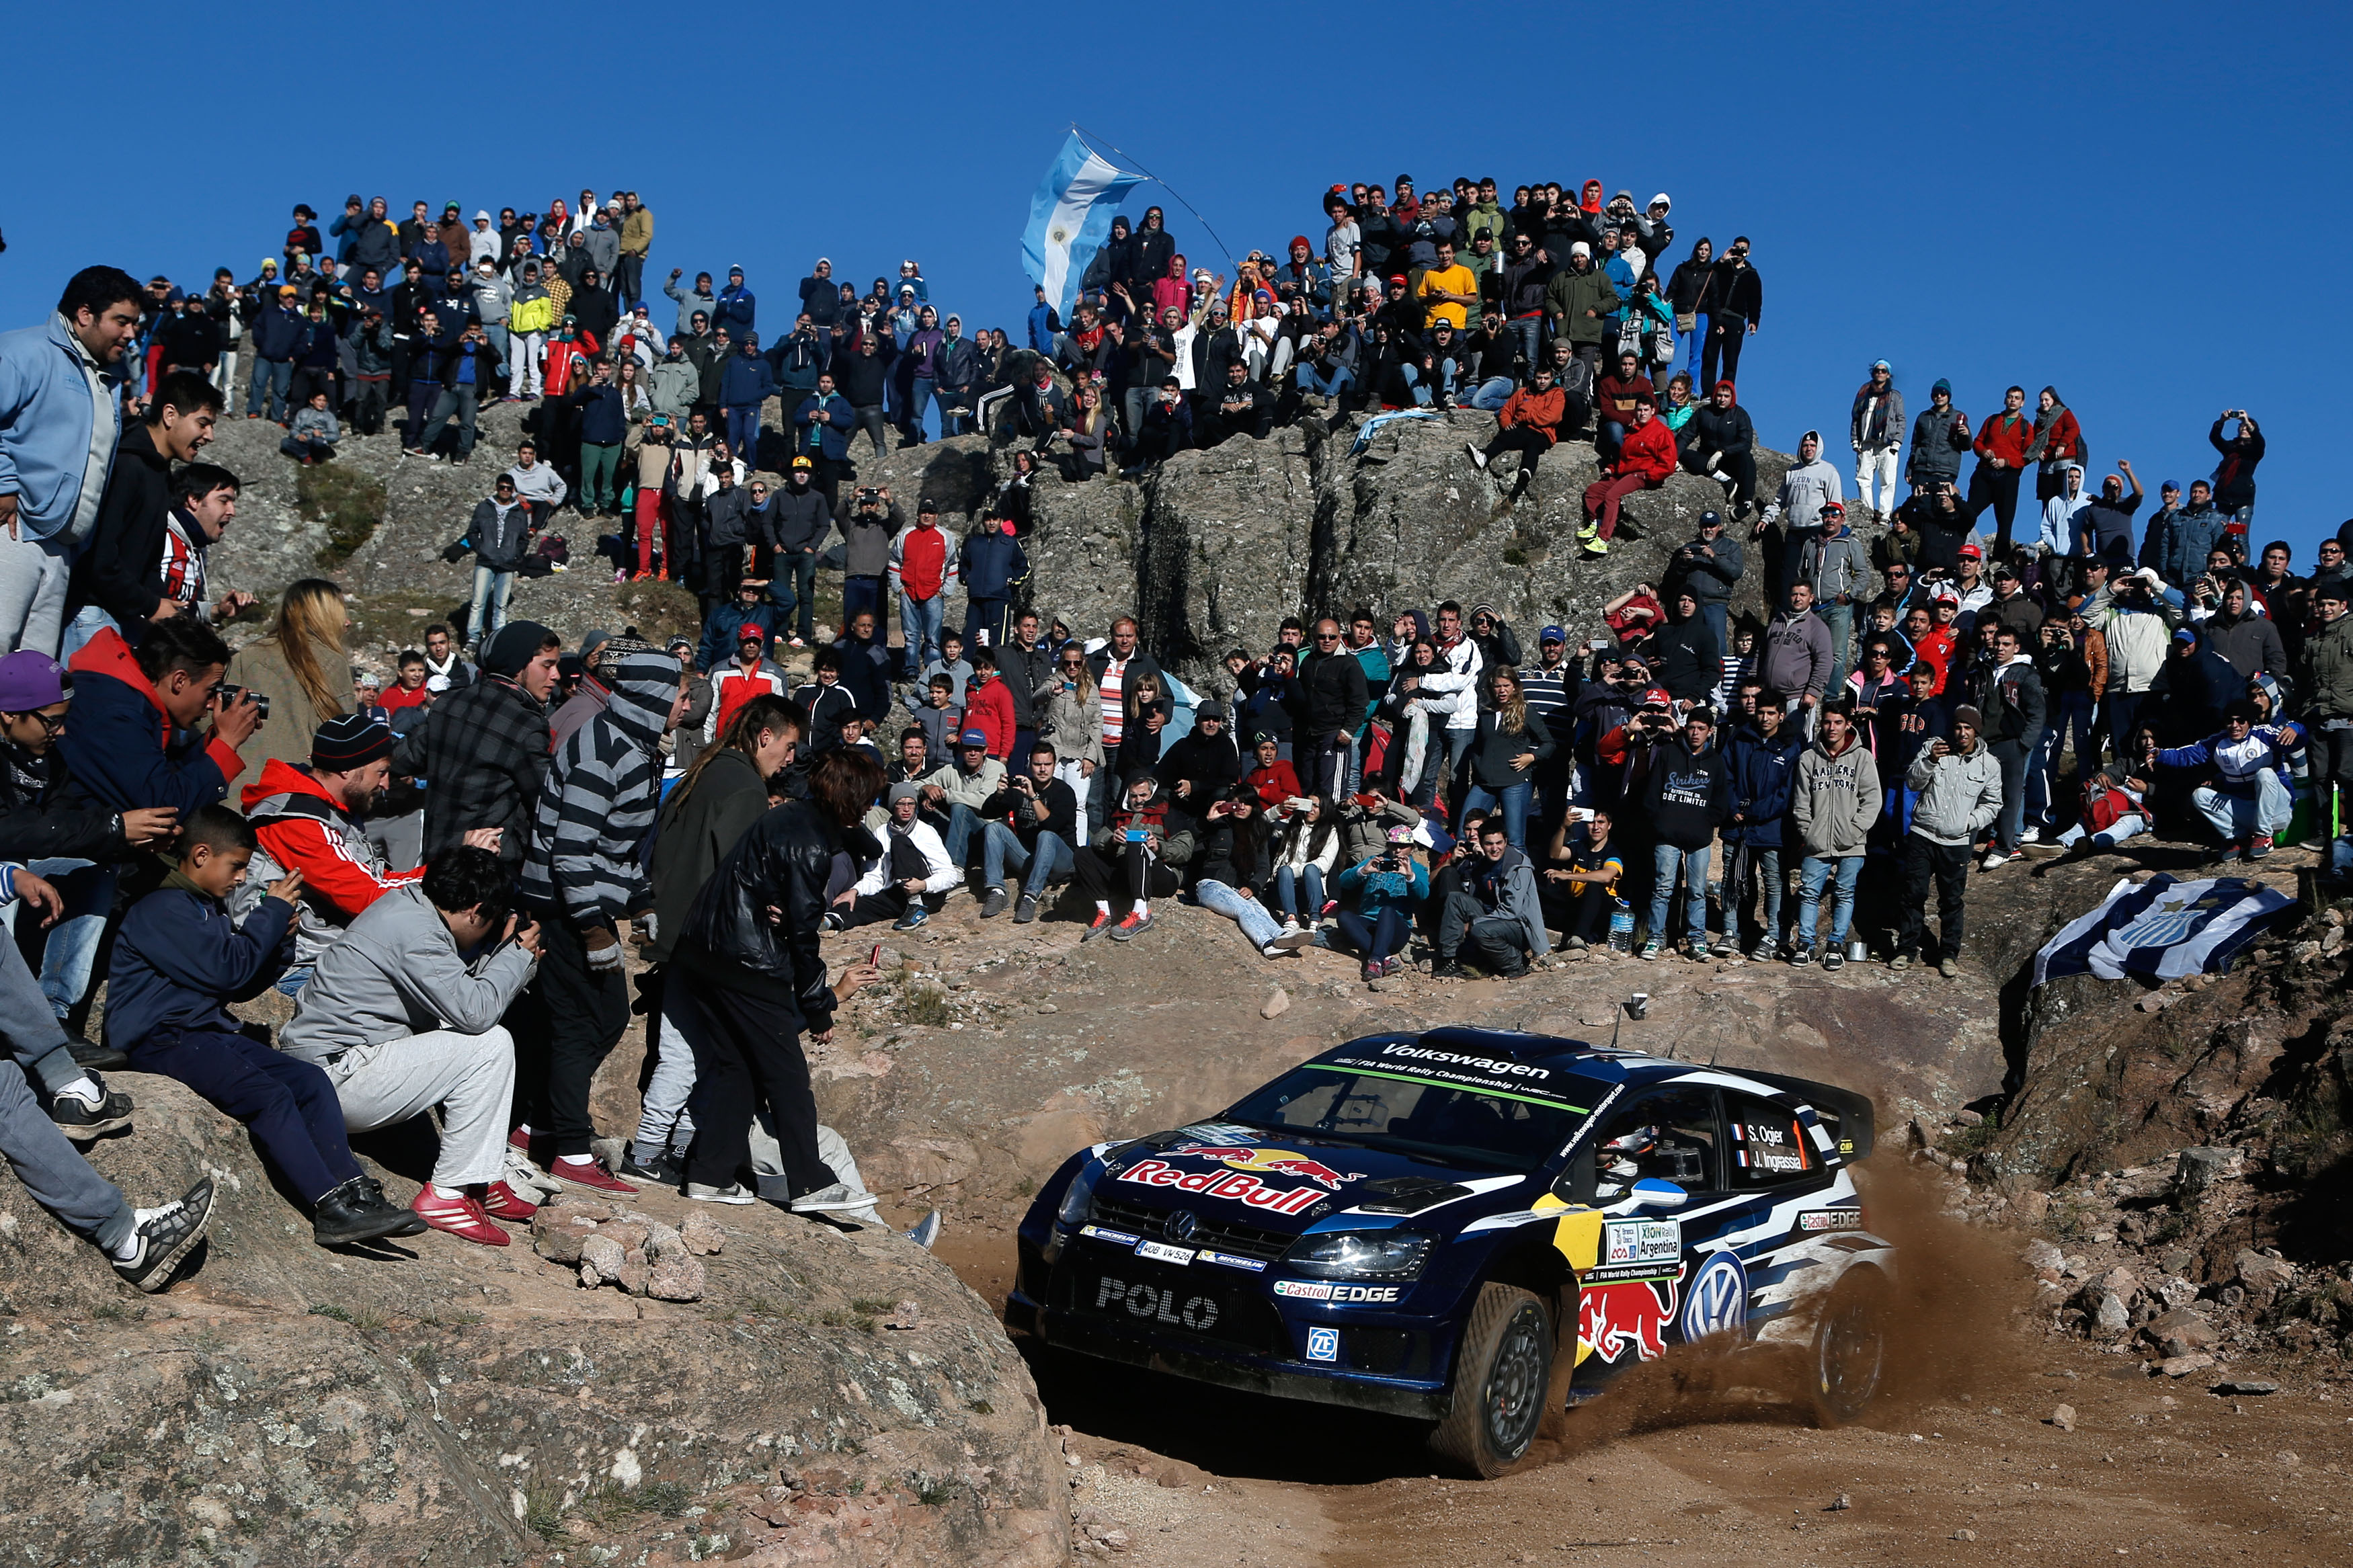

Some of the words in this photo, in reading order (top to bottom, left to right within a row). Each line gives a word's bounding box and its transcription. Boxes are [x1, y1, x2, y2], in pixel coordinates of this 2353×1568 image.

[1900, 713, 1925, 735] GAP
[1665, 772, 1710, 790] Strikers
[1834, 779, 1856, 792] YORK
[1382, 1043, 1550, 1079] Volkswagen
[1377, 1062, 1407, 1071] World
[1406, 1066, 1435, 1076] Rally
[1436, 1070, 1513, 1089] Championship
[1560, 1083, 1625, 1157] www.volkswagen-motorsport.com
[1748, 1124, 1759, 1142] S.
[1759, 1125, 1783, 1147] Ogier
[1793, 1120, 1807, 1169] 1
[1754, 1150, 1762, 1168] J.
[1763, 1151, 1802, 1173] Ingrassia
[1119, 1160, 1231, 1191] Red
[1208, 1174, 1326, 1213] Bull
[1808, 1213, 1829, 1229] Castrol
[1831, 1212, 1861, 1229] EDGE
[1097, 1230, 1137, 1242] MICHELIN
[1642, 1227, 1661, 1239] XION
[1662, 1227, 1675, 1239] Rally
[1143, 1244, 1160, 1254] WOB
[1640, 1239, 1677, 1257] Argentina
[1218, 1252, 1264, 1268] MICHELIN
[1607, 1270, 1620, 1278] World
[1630, 1268, 1657, 1276] Championship
[1287, 1283, 1328, 1298] Castrol
[1330, 1286, 1400, 1302] EDGE
[1096, 1276, 1218, 1330] POLO
[1312, 1335, 1334, 1352] ZF
